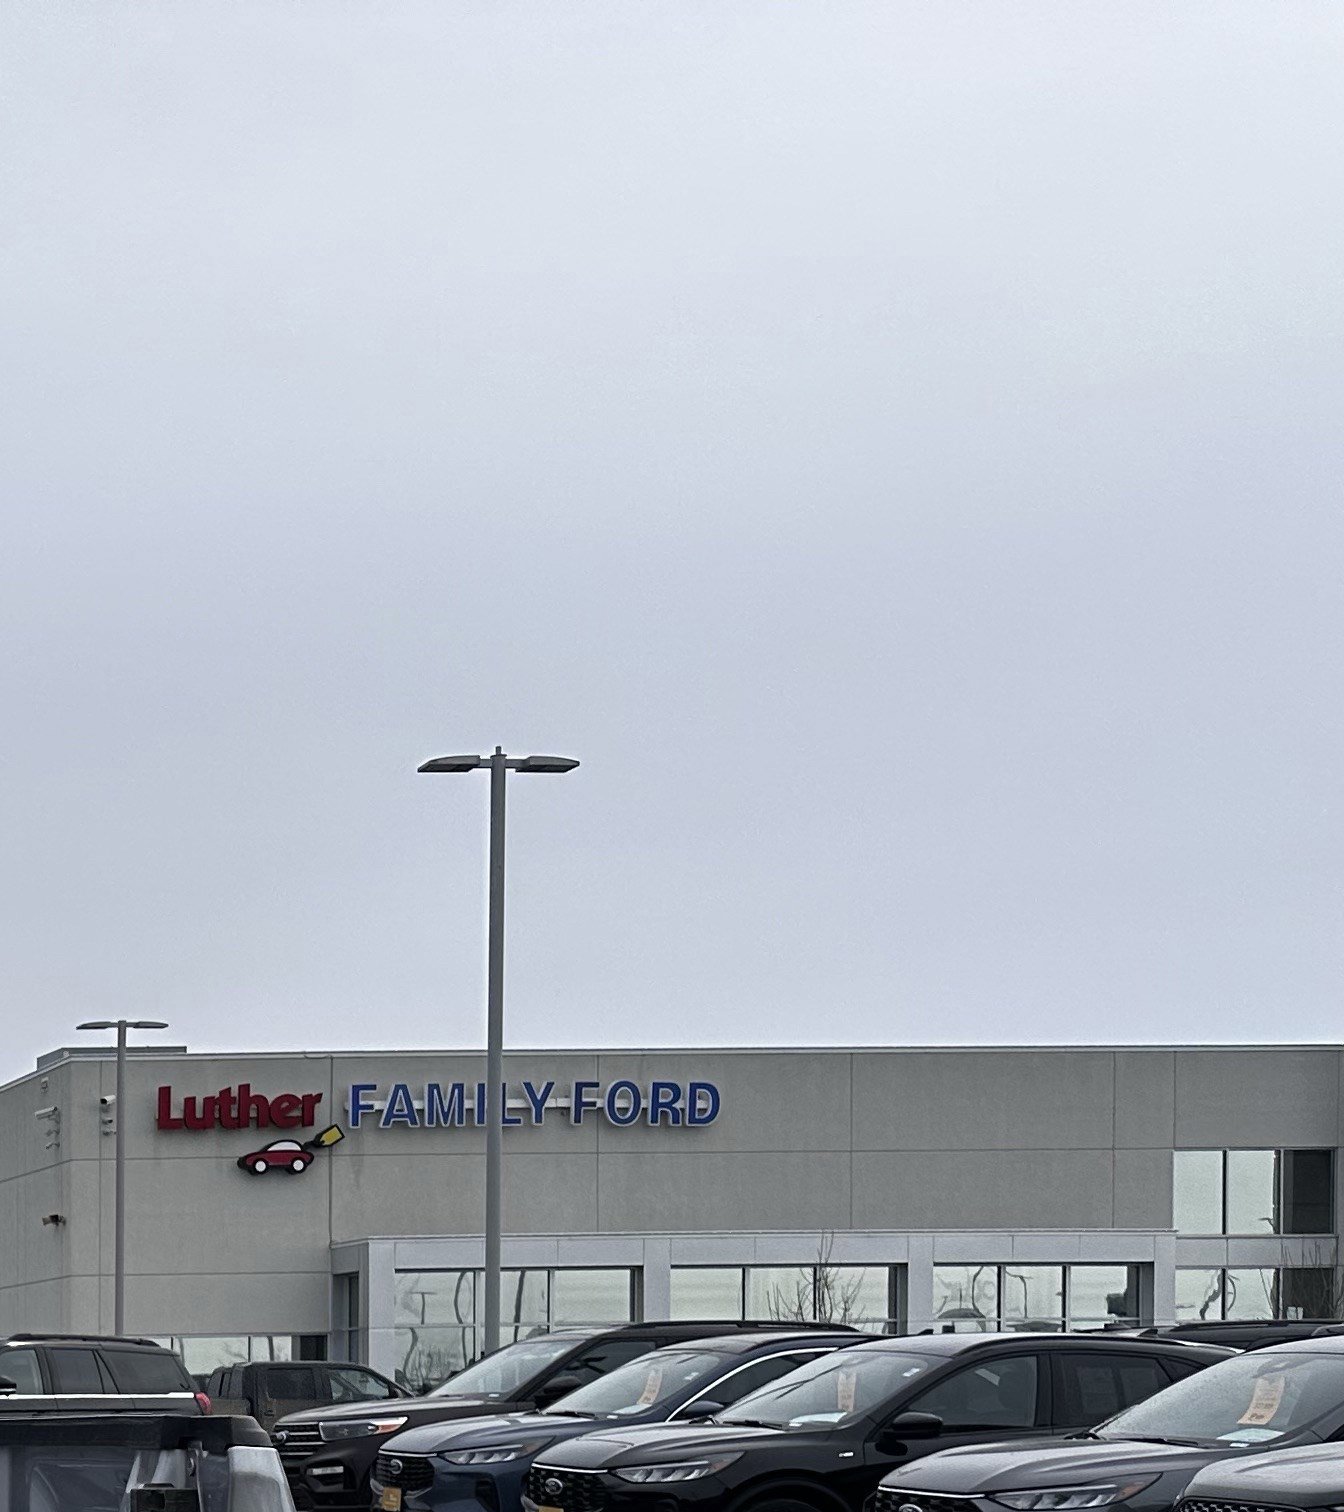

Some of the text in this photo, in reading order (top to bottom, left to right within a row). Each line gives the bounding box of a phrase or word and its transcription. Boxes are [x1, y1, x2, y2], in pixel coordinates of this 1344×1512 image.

[157, 1080, 721, 1130] Luther FAMILY FORD
